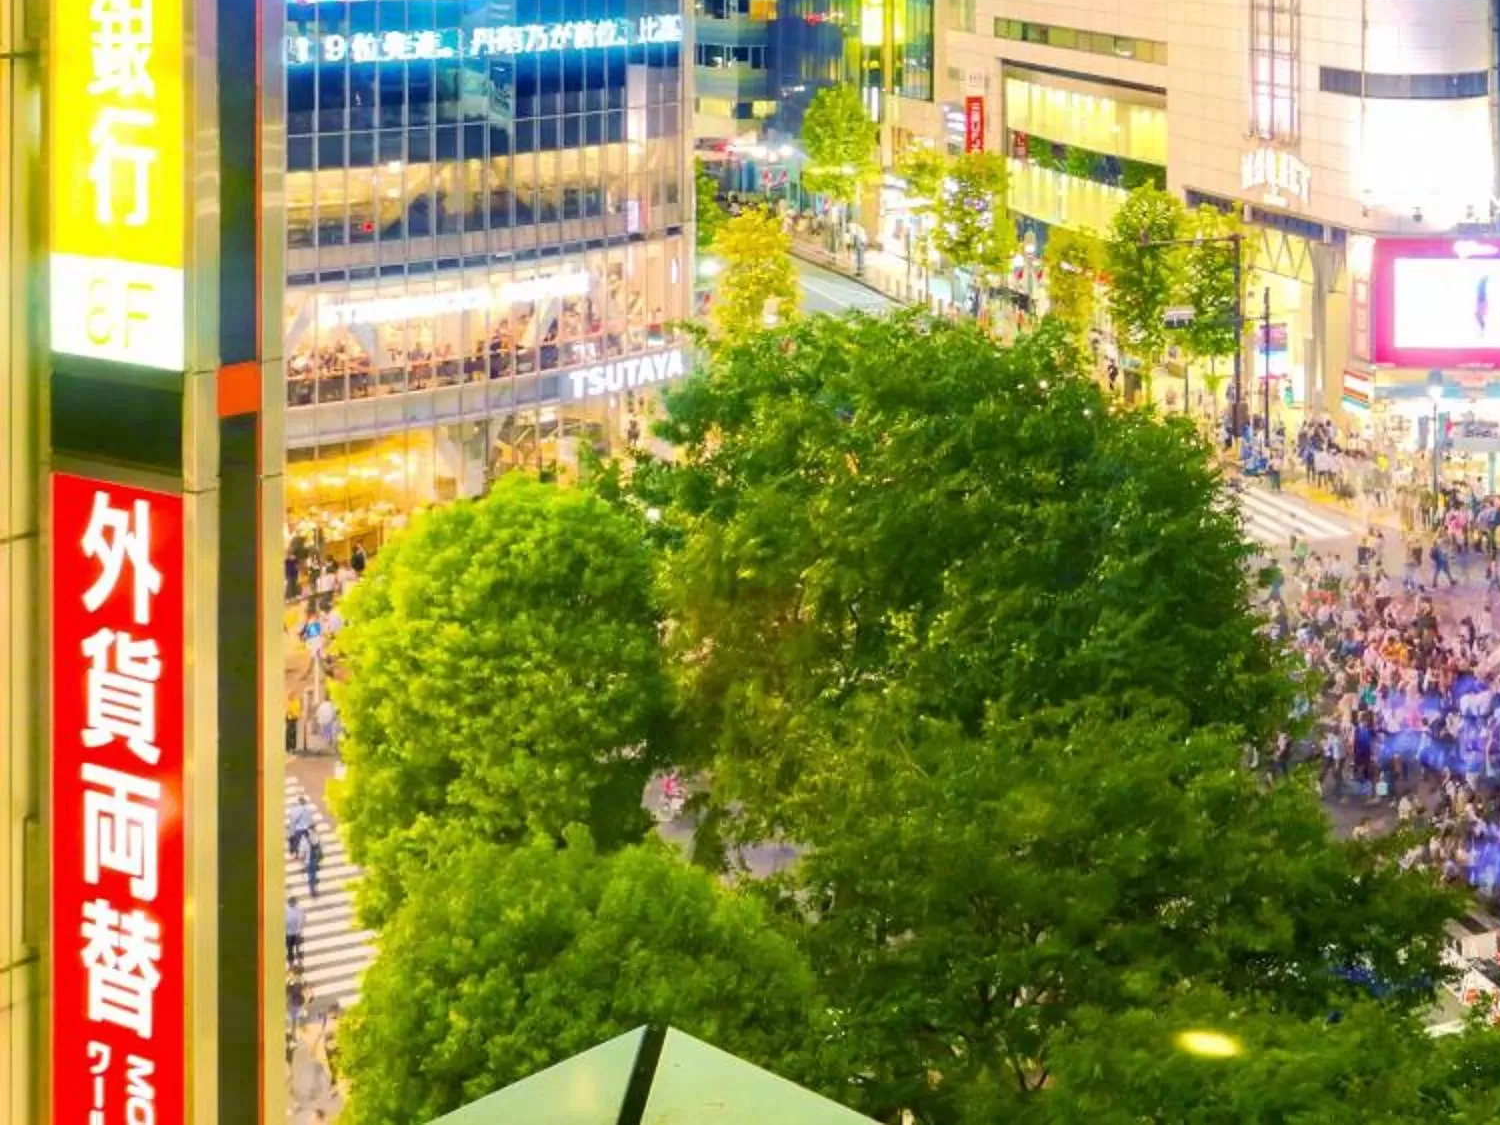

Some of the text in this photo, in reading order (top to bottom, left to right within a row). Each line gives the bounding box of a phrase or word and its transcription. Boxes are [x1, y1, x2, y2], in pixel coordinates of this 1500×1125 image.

[570, 348, 684, 399] TSUTAYA
[80, 491, 163, 1040] 外貨両替
